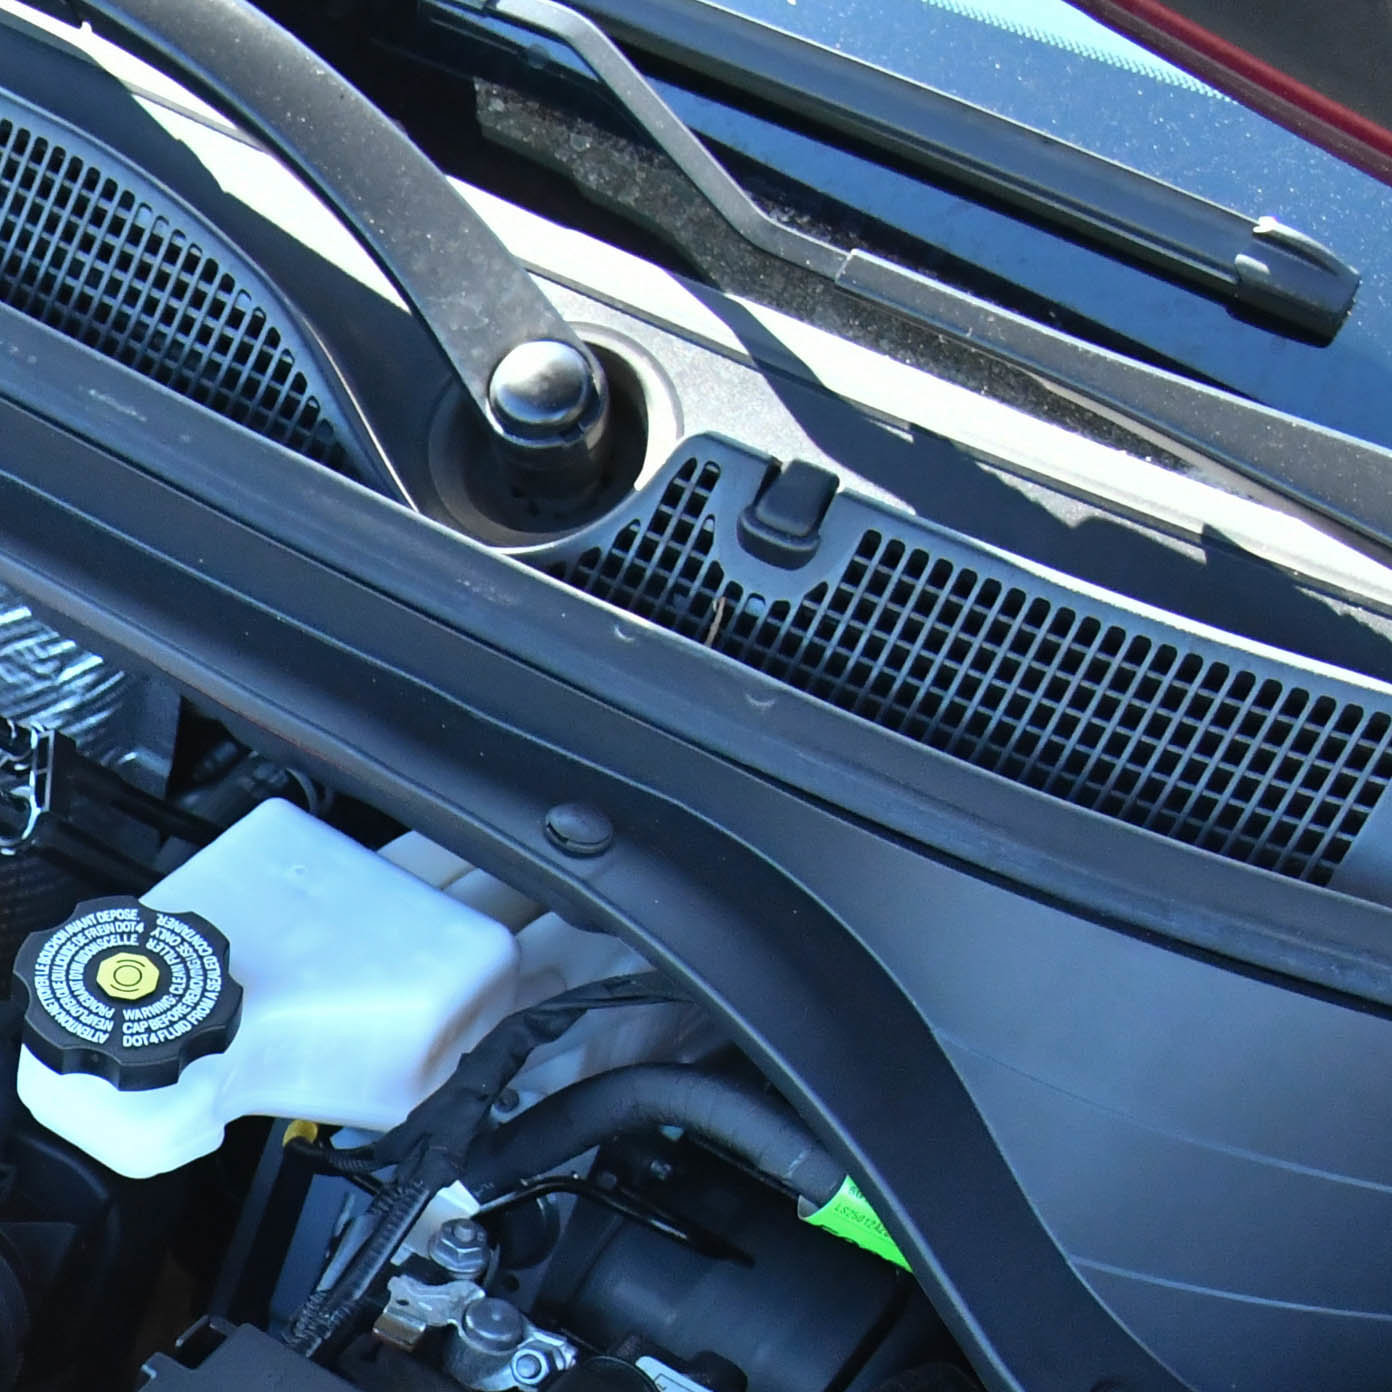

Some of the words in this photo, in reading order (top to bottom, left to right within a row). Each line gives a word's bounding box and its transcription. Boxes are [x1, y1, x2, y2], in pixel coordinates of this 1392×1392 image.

[150, 927, 181, 946] ONLY
[156, 914, 212, 956] CONTAINER.
[146, 938, 180, 965] FILLER
[175, 942, 197, 961] USE
[169, 964, 187, 995] CLEAN
[203, 956, 222, 991] SEALED
[123, 995, 178, 1020] WARNING:
[148, 1002, 191, 1030] BEFORE
[186, 997, 215, 1025] FROM
[122, 1021, 148, 1034] CAP
[122, 1034, 148, 1047] DOT
[157, 1020, 192, 1042] FLUID
